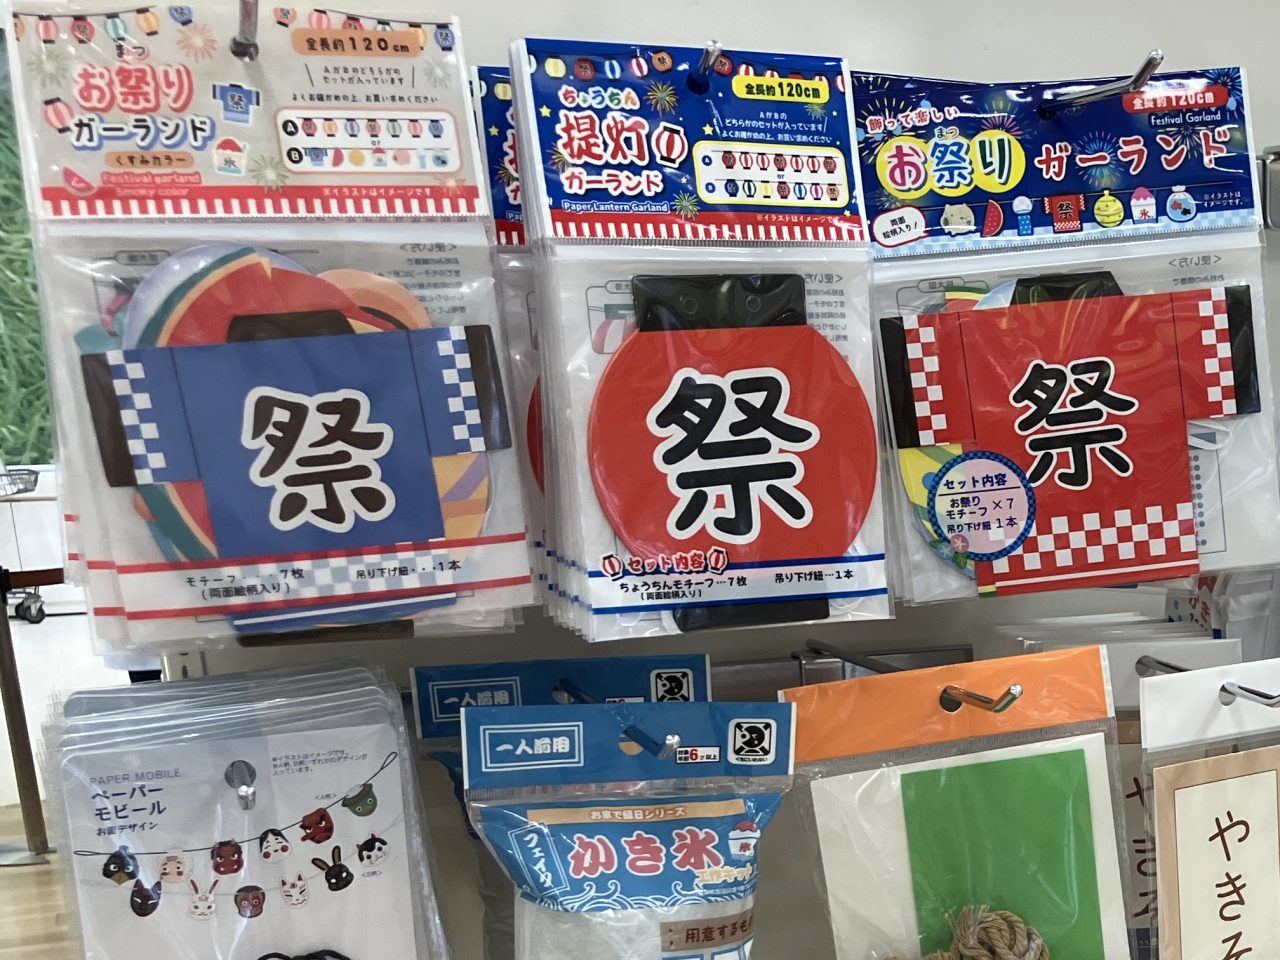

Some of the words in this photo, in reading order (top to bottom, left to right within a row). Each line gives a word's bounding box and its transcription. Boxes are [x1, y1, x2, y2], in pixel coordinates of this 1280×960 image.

[74, 65, 192, 113] お祭り
[559, 86, 640, 109] ちょうちん
[744, 82, 821, 99] 全長約120cm
[759, 111, 788, 120] AかBの
[866, 105, 961, 133] 飾って楽しい
[1150, 114, 1183, 126] Festival
[1185, 111, 1222, 123] Garland
[72, 114, 212, 148] ガーランド
[558, 112, 649, 164] 提灯
[933, 127, 960, 140] まつ
[370, 139, 382, 147] or
[115, 155, 188, 166] くすみカラー
[1034, 128, 1231, 182] ガーランド
[885, 137, 1012, 191] お祭り
[562, 170, 662, 196] ガーランド
[564, 201, 592, 213] Paper
[593, 202, 631, 213] Lantern
[632, 202, 669, 213] Garland
[1057, 201, 1074, 219] 祭
[1139, 208, 1151, 221] 氷
[1010, 358, 1137, 489] 祭
[247, 391, 392, 529] 祭
[652, 372, 817, 541] 祭
[943, 473, 1008, 490] セット内容
[949, 495, 981, 509] お祭り
[945, 506, 988, 520] モチーフ
[626, 553, 706, 575] セット内容
[494, 736, 572, 756] 一人前用
[689, 748, 699, 761] 6
[90, 773, 131, 785] PAPER
[134, 768, 182, 782] MOBILE
[91, 784, 164, 801] ペーパー
[94, 800, 167, 822] モビール
[589, 806, 687, 821] お家で縁日シリーズ
[96, 821, 158, 837] お面デザイン
[567, 825, 726, 879] かき氷
